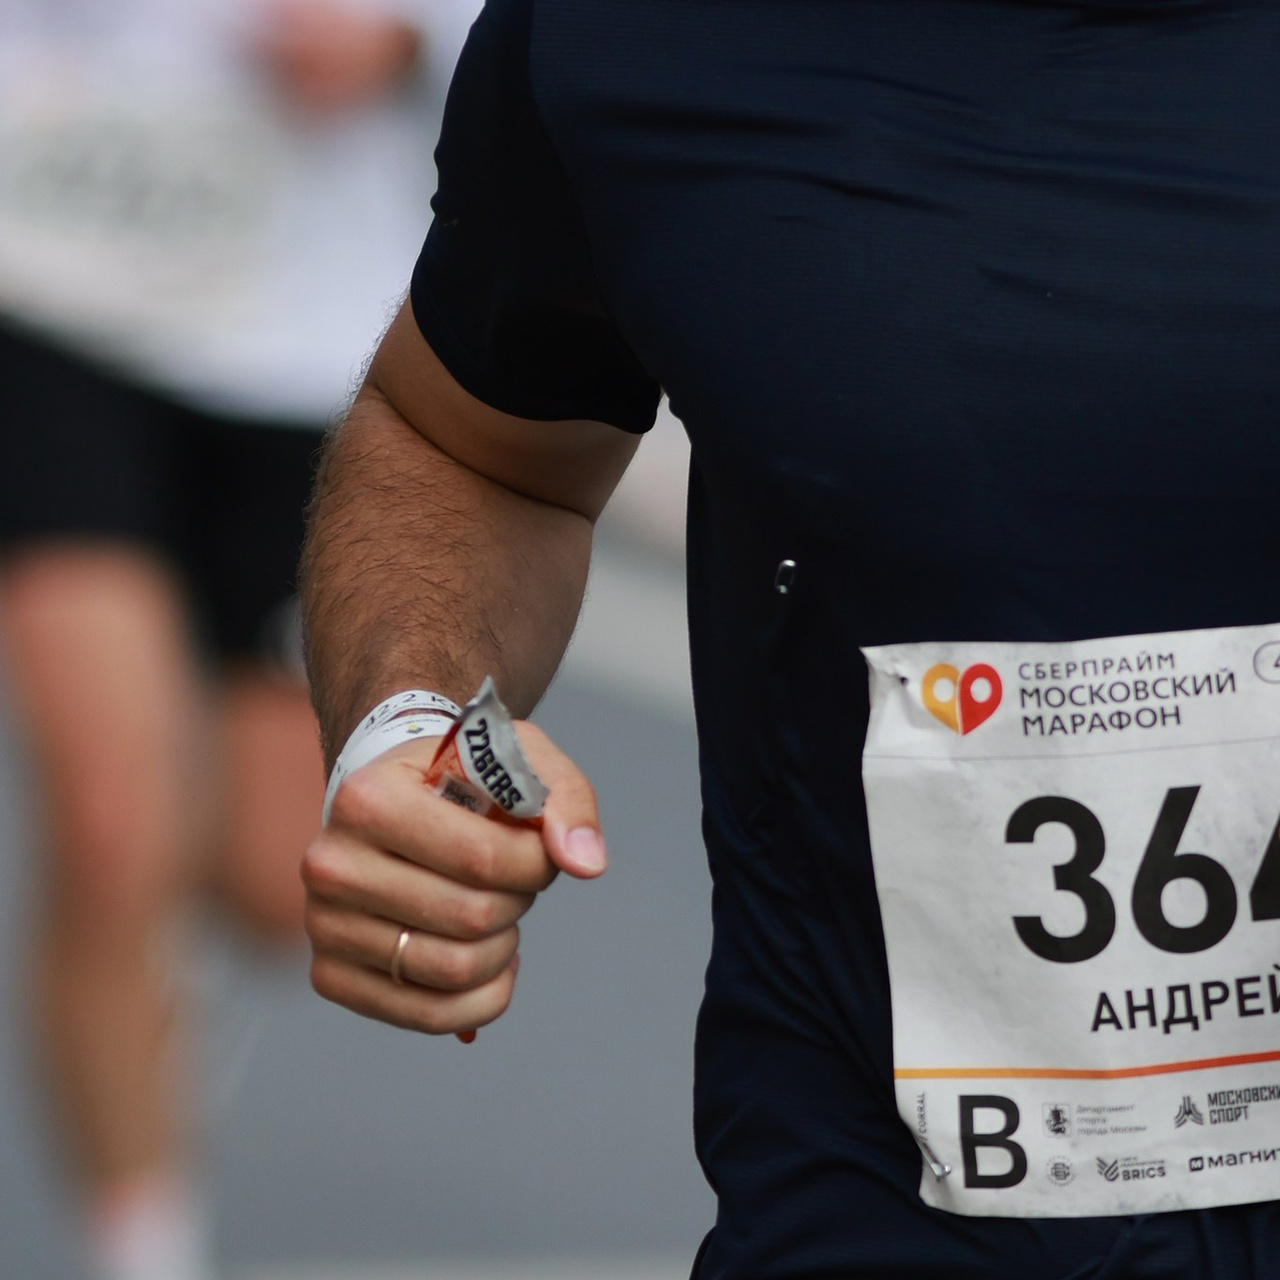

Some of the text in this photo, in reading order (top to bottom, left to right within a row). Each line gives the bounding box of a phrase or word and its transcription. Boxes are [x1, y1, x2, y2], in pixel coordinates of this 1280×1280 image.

[1018, 651, 1175, 681] СБЕРПРАЙМ
[1020, 668, 1236, 709] МОСКОВСКИЙ
[1022, 706, 1181, 736] МАРАФОН
[464, 718, 524, 811] 226ERS
[1209, 1105, 1248, 1125] СПОРТ
[1122, 1166, 1166, 1181] BRICS
